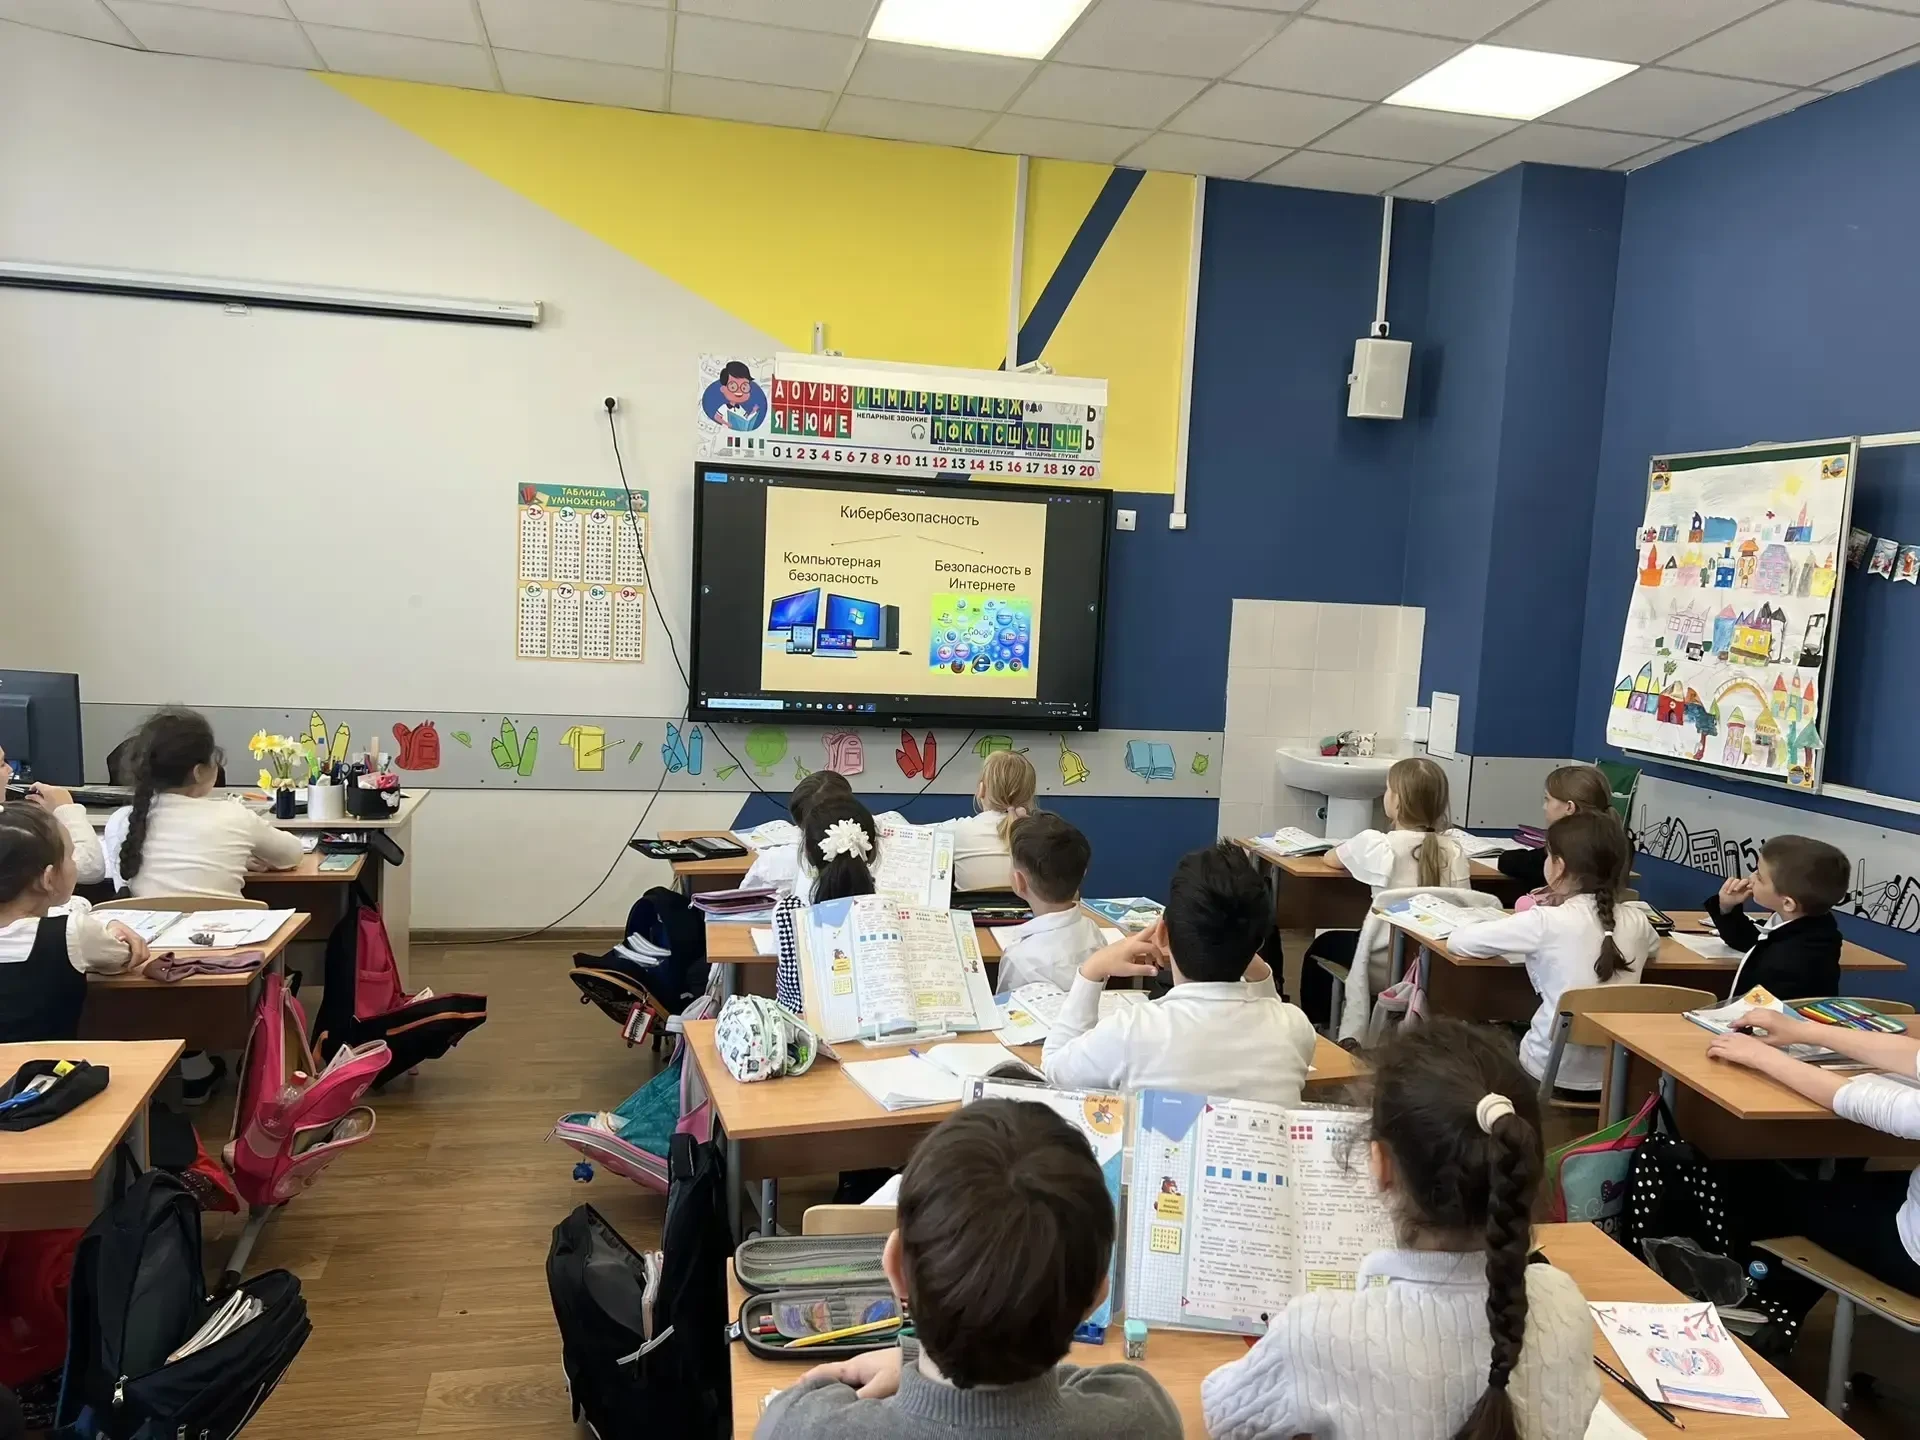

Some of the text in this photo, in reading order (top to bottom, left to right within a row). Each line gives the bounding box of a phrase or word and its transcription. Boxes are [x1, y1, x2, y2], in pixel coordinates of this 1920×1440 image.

[857, 412, 895, 421] НЕПАРНЫЕ
[773, 446, 781, 457] 0
[786, 447, 792, 458] 1
[797, 448, 805, 459] 2
[809, 449, 817, 460] 3
[821, 450, 830, 461] 4
[835, 451, 842, 461] 5
[847, 452, 855, 462] 6
[860, 452, 867, 463] 7
[871, 453, 879, 464] 8
[884, 454, 892, 464] 9
[896, 455, 910, 466] 10
[915, 456, 928, 467] 11
[933, 457, 947, 468] 12
[952, 458, 966, 469] 13
[970, 459, 984, 470] 14
[989, 460, 1003, 471] 15
[1008, 461, 1022, 472] 16
[1026, 463, 1040, 473] 17
[1044, 464, 1057, 474] 18
[1062, 465, 1076, 475] 19
[1079, 465, 1095, 476] 20
[562, 488, 606, 497] ТАБЛИЦА
[551, 497, 616, 507] УМНОЖЕНИЯ
[840, 505, 980, 526] Кибербезопасность
[783, 551, 881, 569] Компьютерная
[935, 560, 1031, 575] Безопасность в
[788, 569, 878, 585] безопасность
[949, 578, 1016, 592] Интернете
